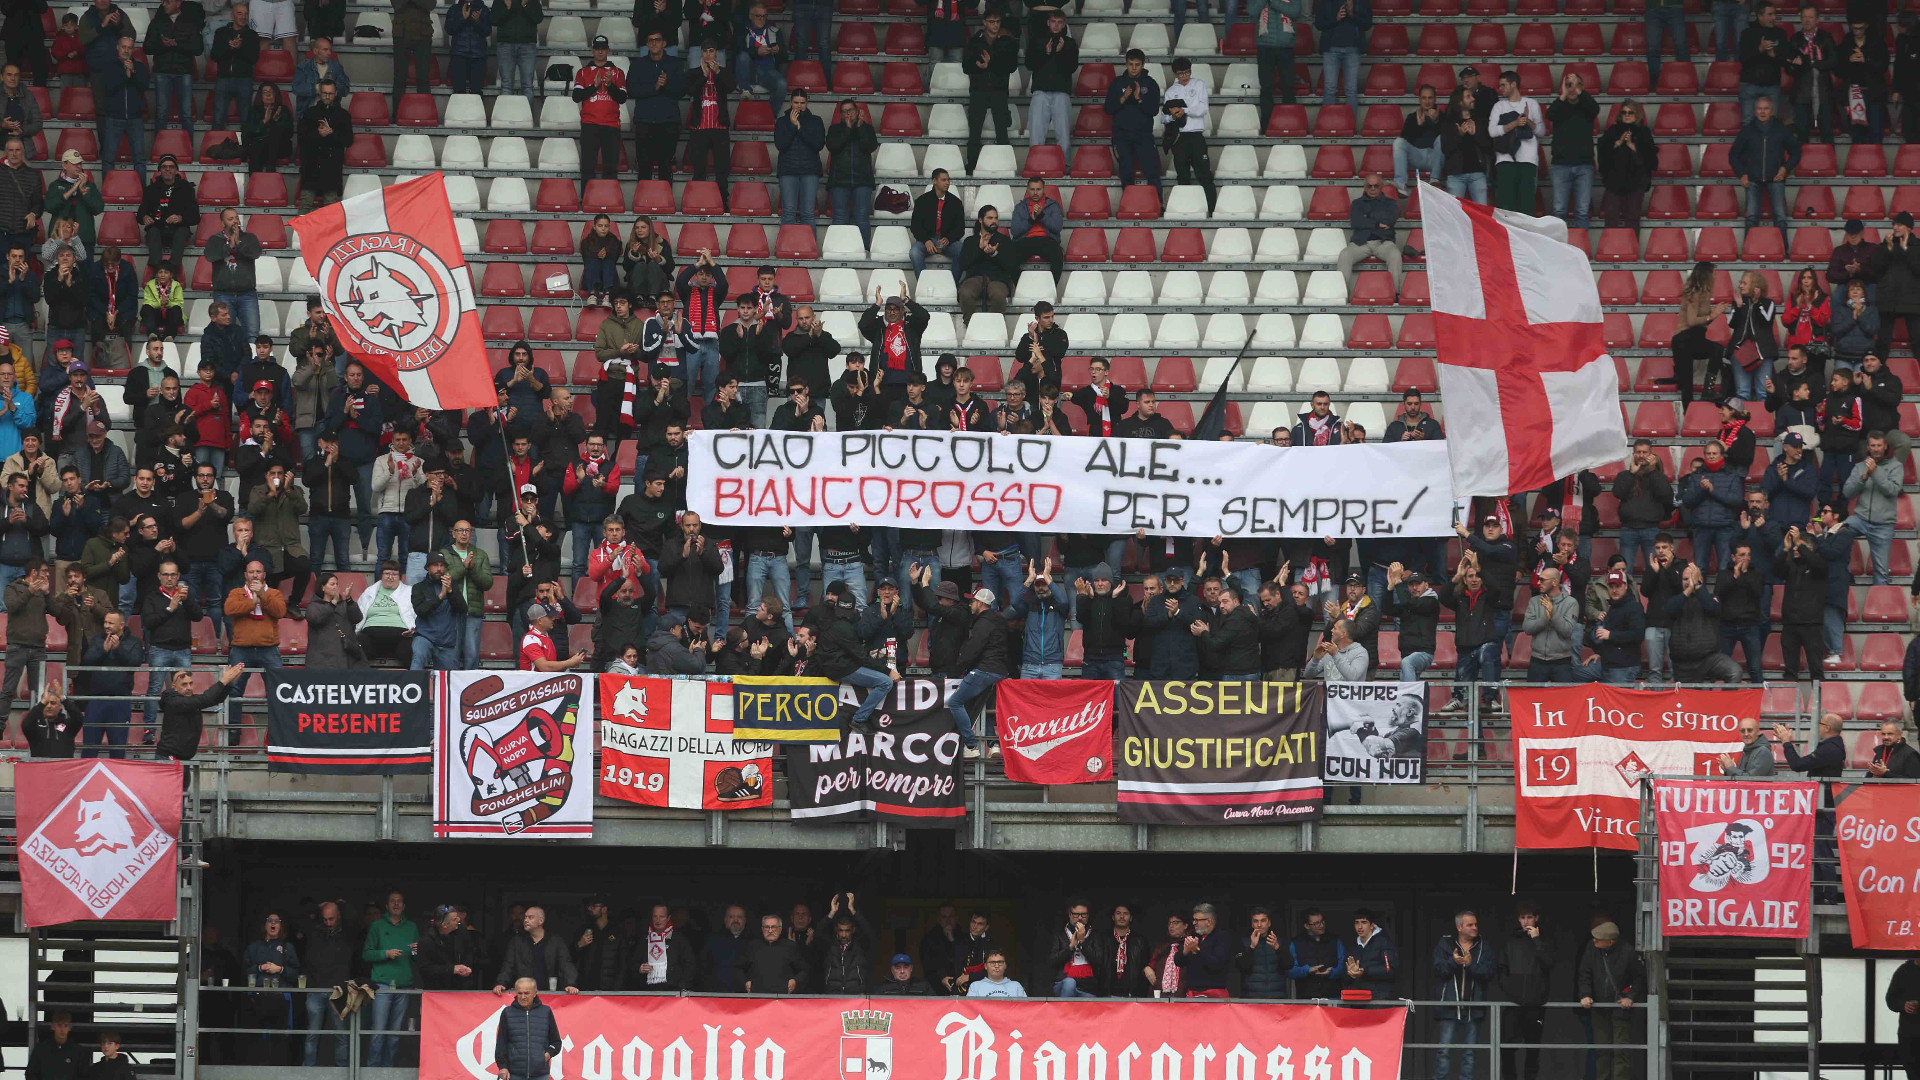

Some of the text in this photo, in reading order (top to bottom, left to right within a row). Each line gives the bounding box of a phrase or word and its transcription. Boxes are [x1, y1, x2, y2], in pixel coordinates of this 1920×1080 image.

[712, 433, 814, 470] CIAO
[841, 434, 1052, 473] PICCOLO
[714, 475, 1063, 527] BIANCOROSSO
[1102, 489, 1190, 531] PER
[1219, 486, 1429, 536] SEMPRE!
[275, 683, 422, 704] CASTELVETRO
[466, 678, 577, 720] SQUADRE D'ASSALTO
[739, 691, 838, 722] PERGO
[1133, 680, 1304, 715] ASSENTI
[1327, 684, 1398, 701] SEMPRE
[298, 713, 401, 734] PRESENTE
[879, 714, 892, 728] e
[1003, 699, 1107, 749] Sparuta
[1531, 697, 1739, 732] In hoc signo
[500, 736, 528, 754] CURVA
[503, 748, 526, 764] NORD
[603, 725, 773, 756] I RAGAZZI DELLA NORD
[809, 731, 962, 766] MARCO
[1124, 731, 1316, 769] GIUSTIFICATI
[603, 763, 665, 793] 1919
[1326, 756, 1420, 779] CON NOI
[1534, 754, 1571, 781] 19
[815, 766, 861, 804] per
[1224, 804, 1315, 819] Curva Nord Piacenza
[1656, 786, 1815, 816] TUMULTEN
[1838, 814, 1898, 849] Gigio
[1858, 865, 1905, 894] Con
[1667, 898, 1799, 929] BRIGADE
[1886, 920, 1914, 936] T.B.
[935, 1011, 1373, 1080] Biancorosso
